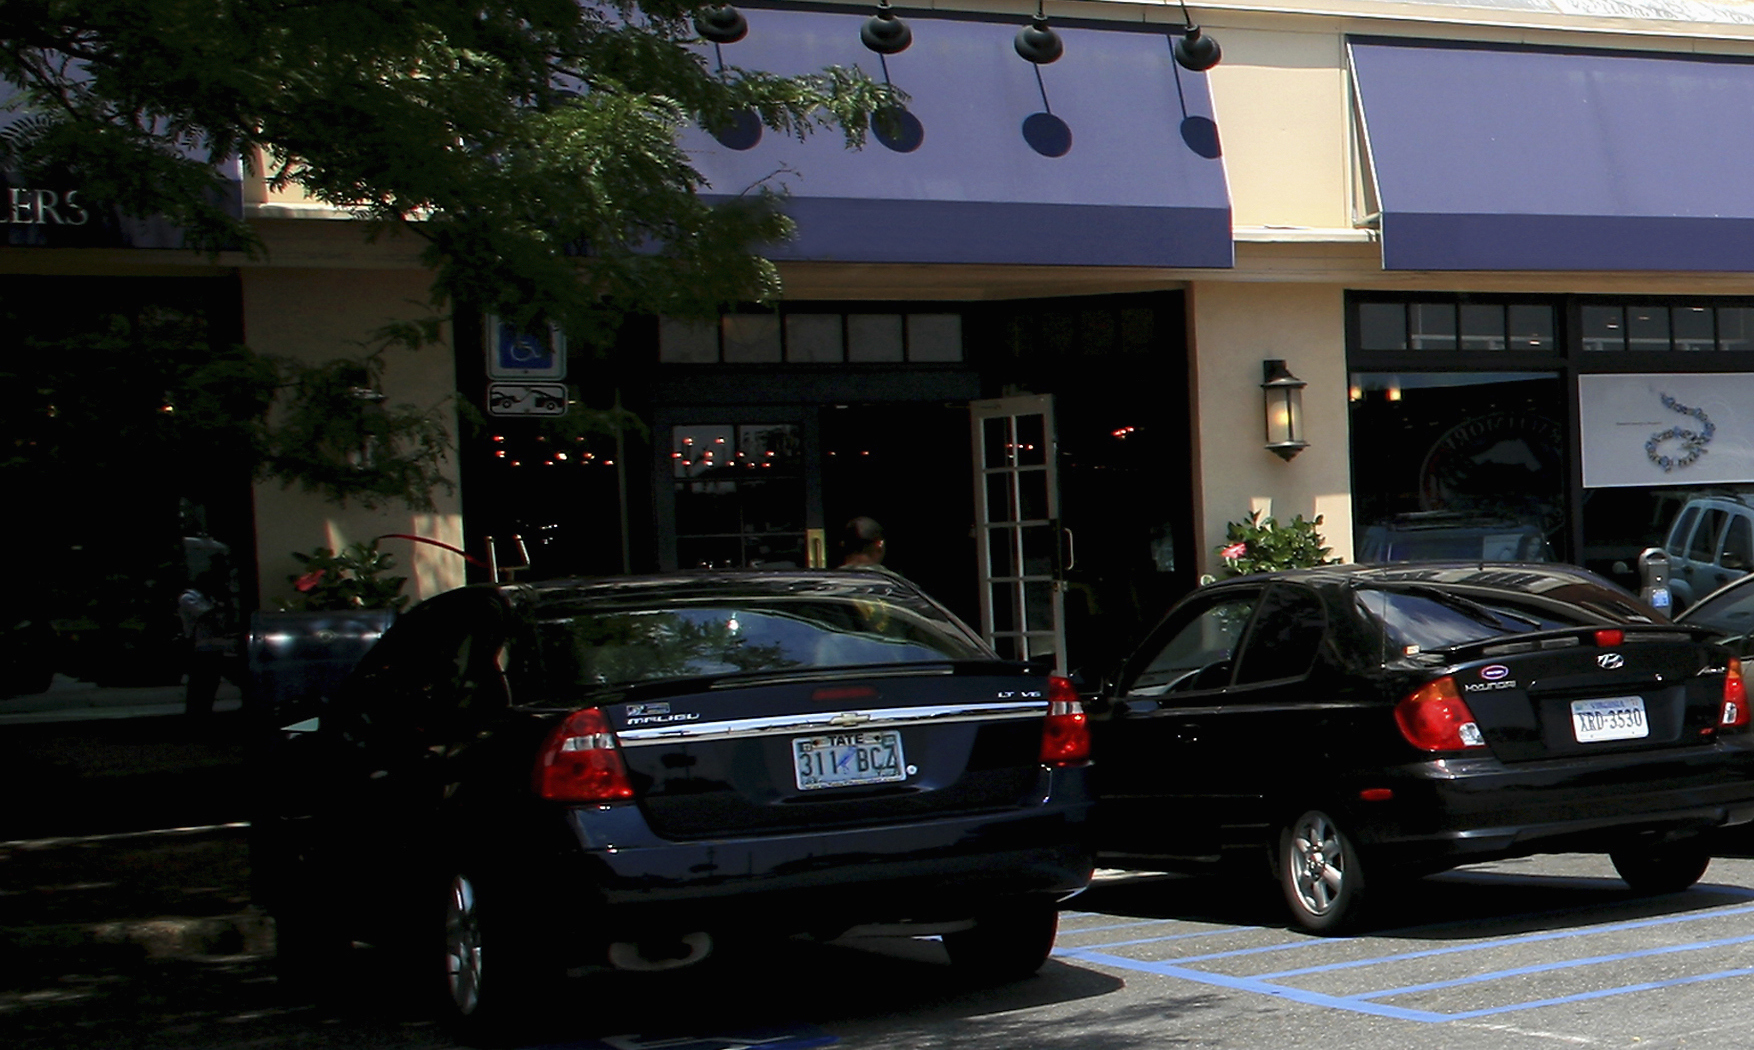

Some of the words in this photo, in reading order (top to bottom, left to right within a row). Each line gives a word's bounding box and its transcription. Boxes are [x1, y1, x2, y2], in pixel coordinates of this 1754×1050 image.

[0, 187, 90, 226] ERS
[1464, 680, 1517, 692] HYUNDAI
[997, 690, 1016, 699] LT
[1020, 690, 1042, 698] V6
[626, 712, 701, 726] MALIBU
[828, 733, 865, 747] TATE
[799, 750, 838, 777] 311
